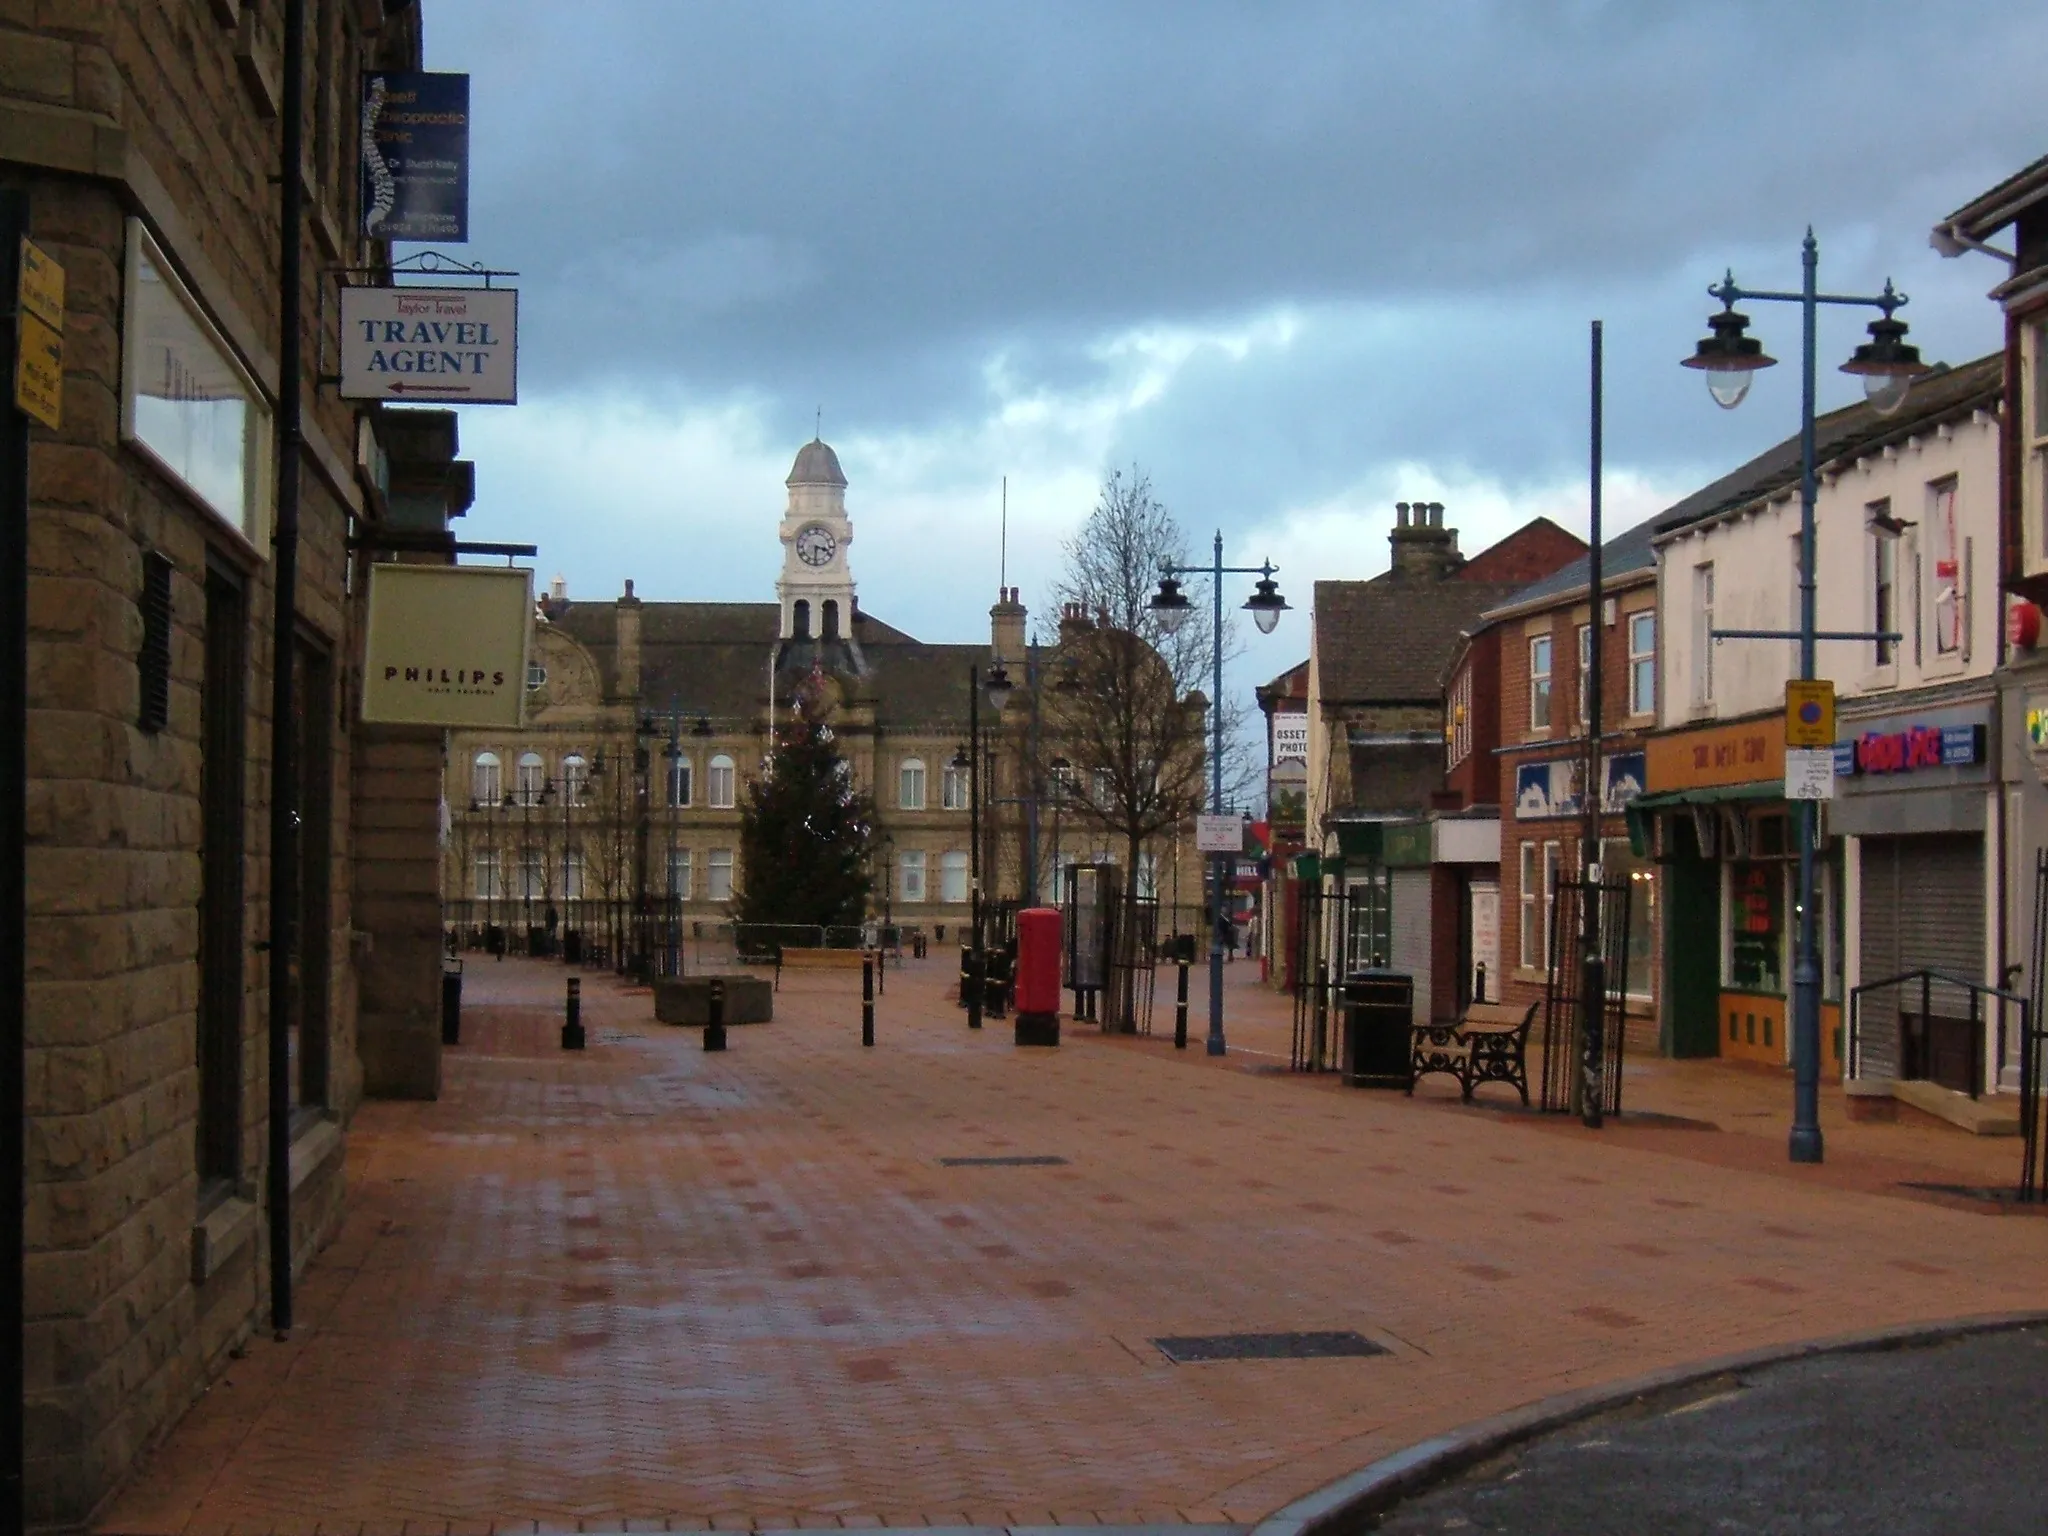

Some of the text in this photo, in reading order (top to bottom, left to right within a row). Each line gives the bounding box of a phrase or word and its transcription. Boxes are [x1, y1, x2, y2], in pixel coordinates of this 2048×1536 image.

[436, 299, 467, 315] Travel
[358, 319, 500, 347] TRAVEL
[366, 349, 490, 375] AGENT
[384, 666, 505, 686] PHILIPS
